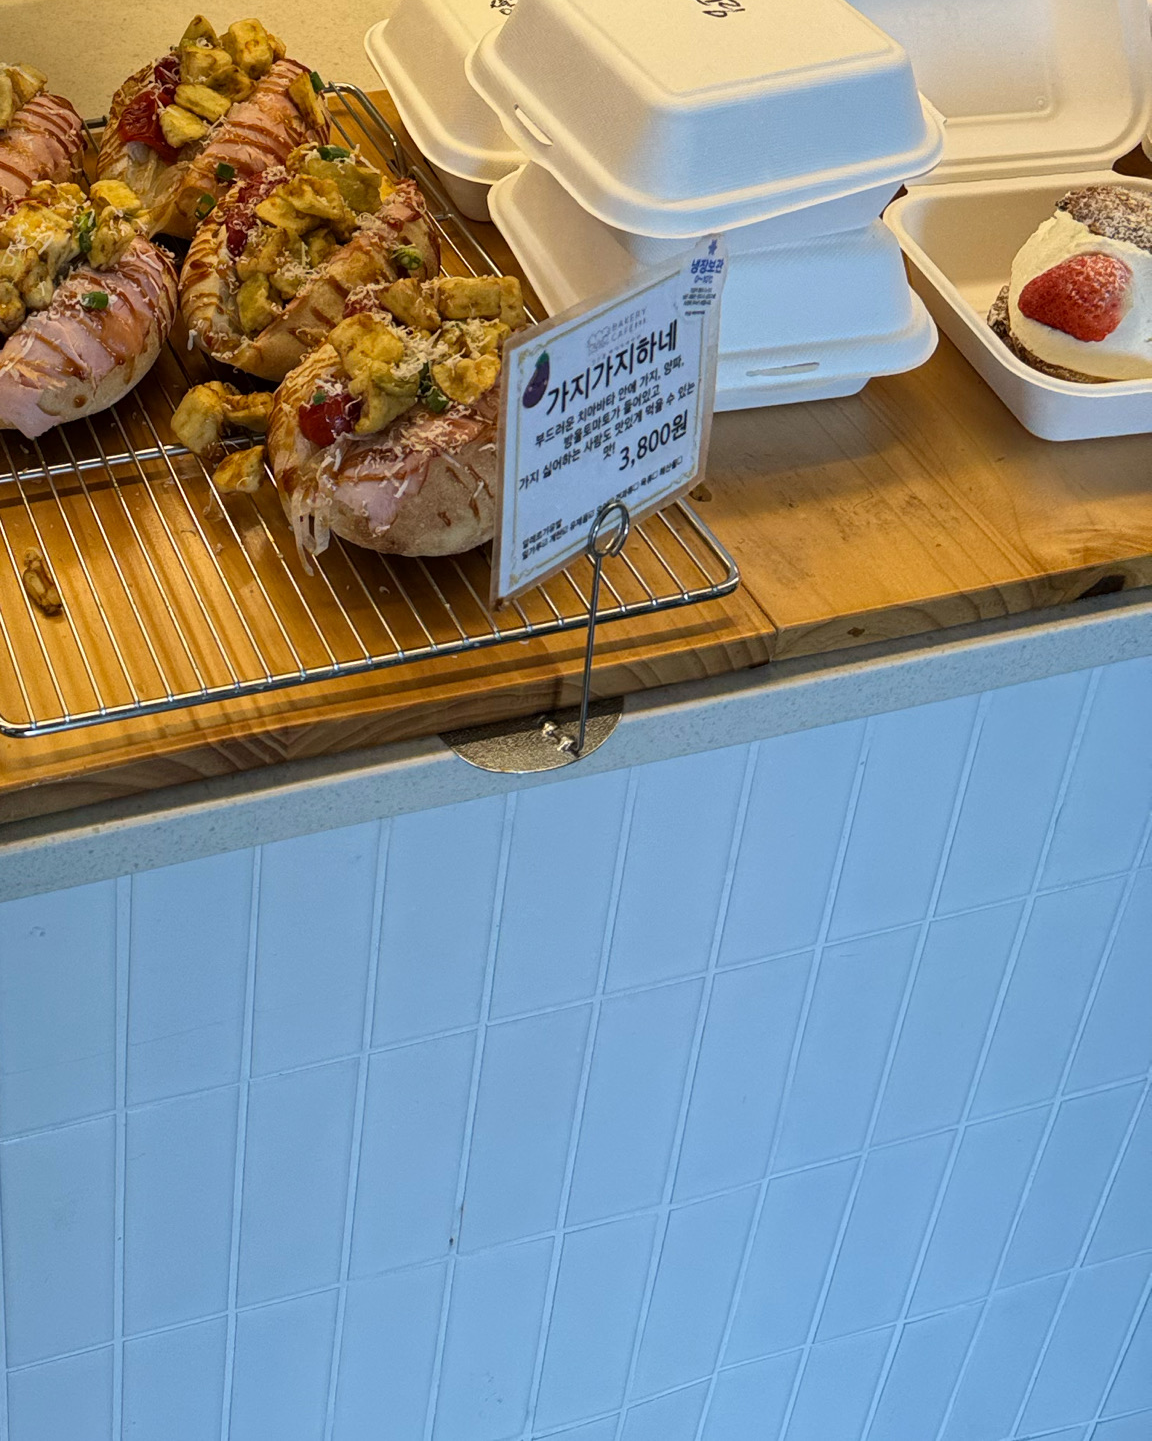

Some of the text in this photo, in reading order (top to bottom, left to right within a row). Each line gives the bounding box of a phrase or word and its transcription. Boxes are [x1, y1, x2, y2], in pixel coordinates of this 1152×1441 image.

[691, 258, 724, 274] 냉장보관
[546, 319, 677, 416] 가지가지하네
[519, 381, 696, 491] 가지 싫어하는 사람도 맛있게 먹을 수 있는
[535, 416, 574, 447] 부드러운
[578, 392, 615, 423] 치아바타
[618, 380, 636, 401] 안에
[563, 384, 661, 450] 방울토마토가 들어있고
[618, 409, 688, 471] 3,800원
